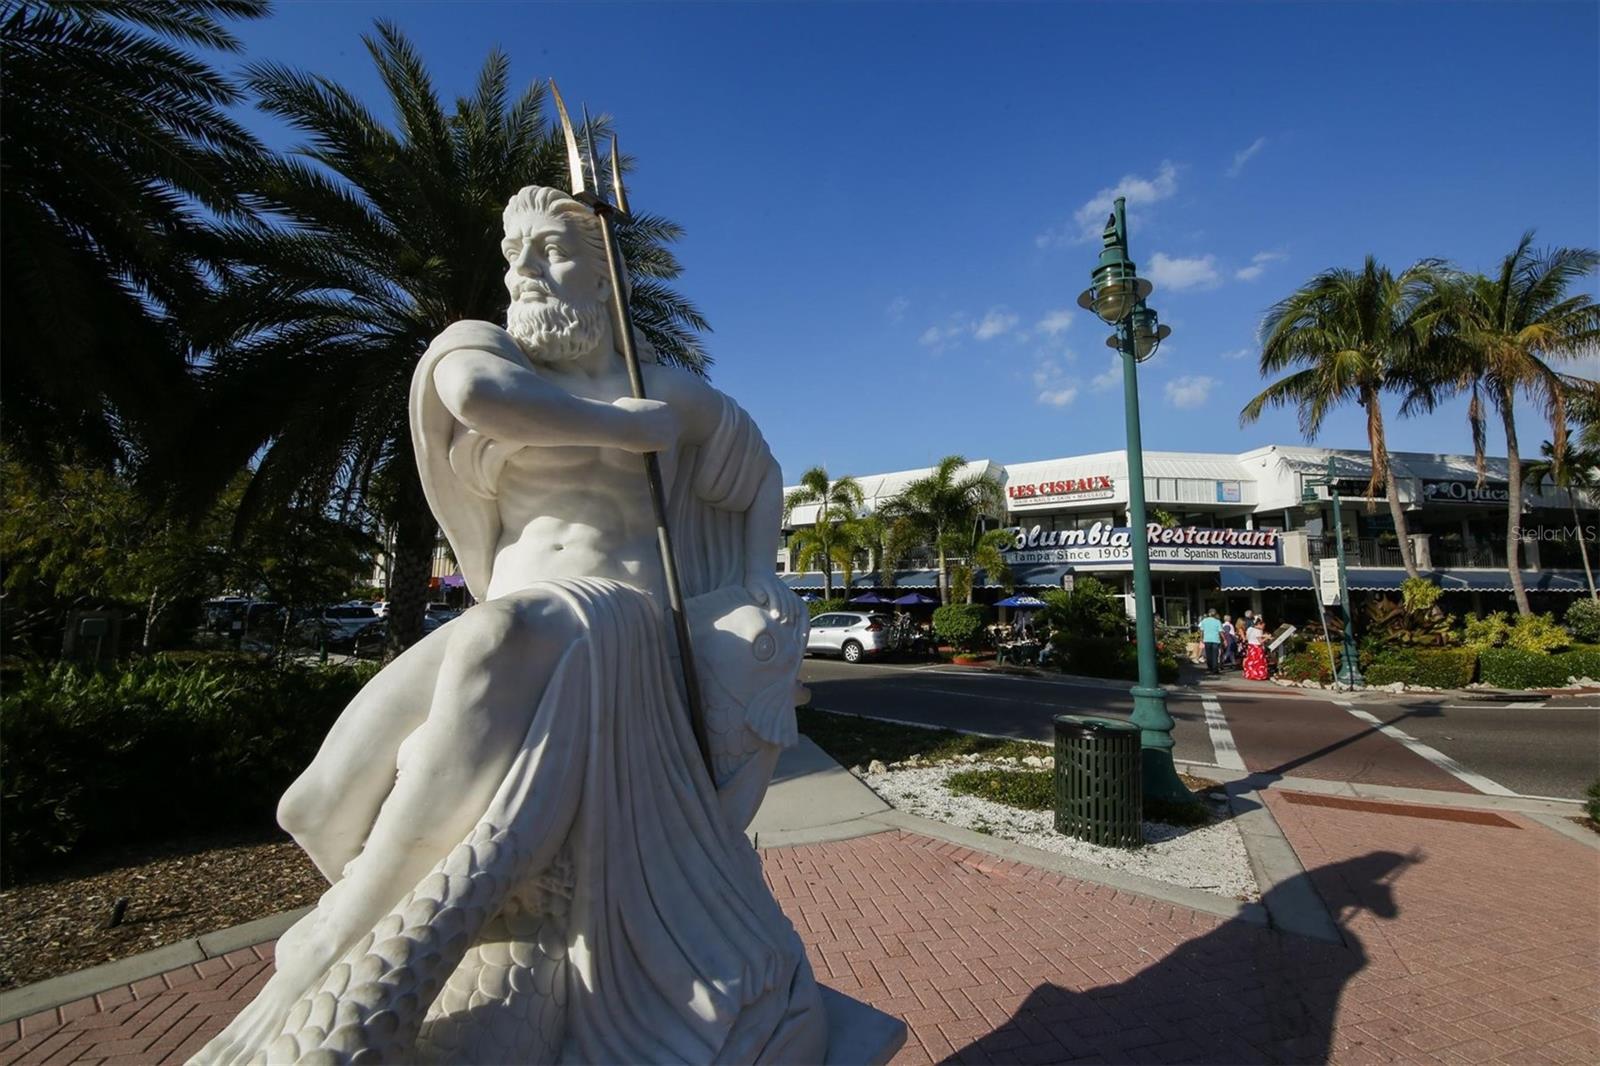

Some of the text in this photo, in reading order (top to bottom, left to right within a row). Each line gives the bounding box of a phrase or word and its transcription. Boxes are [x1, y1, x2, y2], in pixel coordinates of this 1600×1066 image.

[1009, 475, 1112, 498] LES CISEAUX
[1147, 523, 1278, 546] Restaurant
[1015, 551, 1050, 563] Tampa
[1057, 550, 1090, 560] Since
[1099, 548, 1129, 559] 1905
[1170, 547, 1180, 558] of
[1184, 548, 1219, 561] Spanish
[1222, 549, 1272, 560] Restaurants
